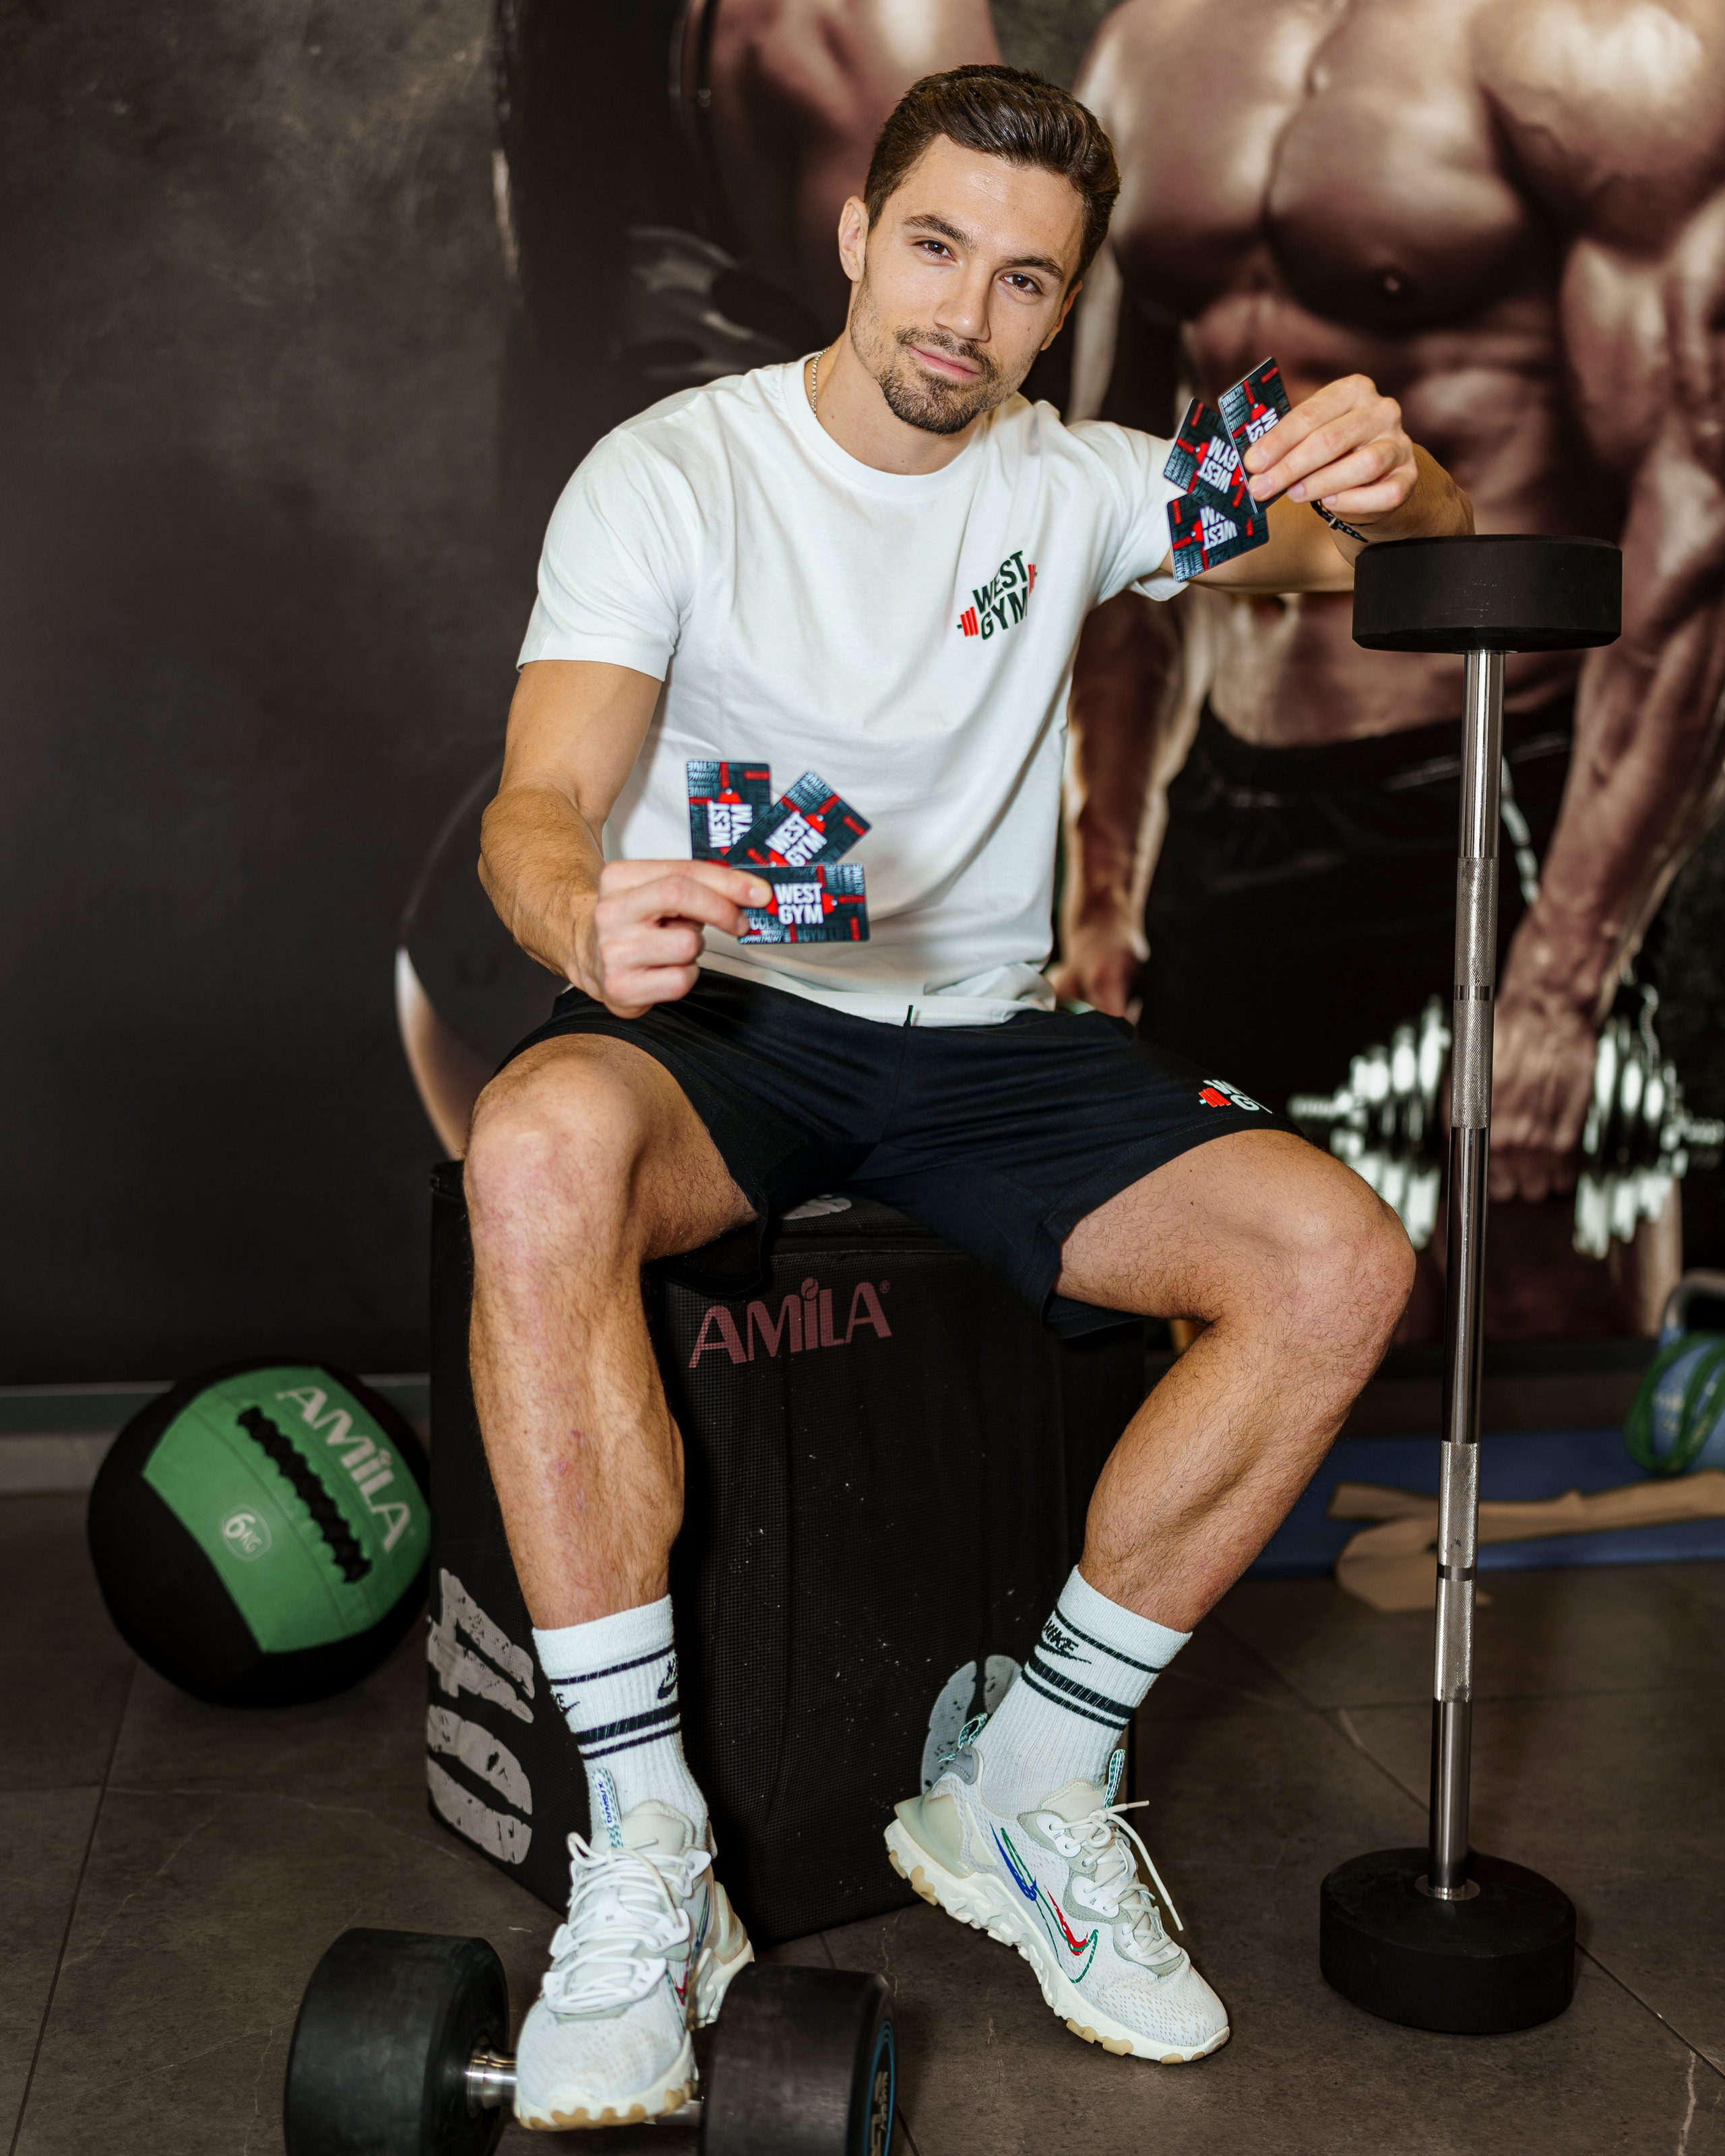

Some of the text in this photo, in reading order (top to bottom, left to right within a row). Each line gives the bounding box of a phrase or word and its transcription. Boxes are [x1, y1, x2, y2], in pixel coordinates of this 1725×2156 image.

[1206, 436, 1238, 472] GYM
[1197, 456, 1232, 494] WEST
[1203, 519, 1238, 551] WEST
[972, 550, 1028, 614] WEST
[981, 586, 1028, 640] GYM
[708, 801, 731, 848] WEST
[765, 811, 811, 855] WEST
[784, 829, 827, 867] GYM
[774, 882, 823, 904] WEST
[778, 903, 824, 925] GYM
